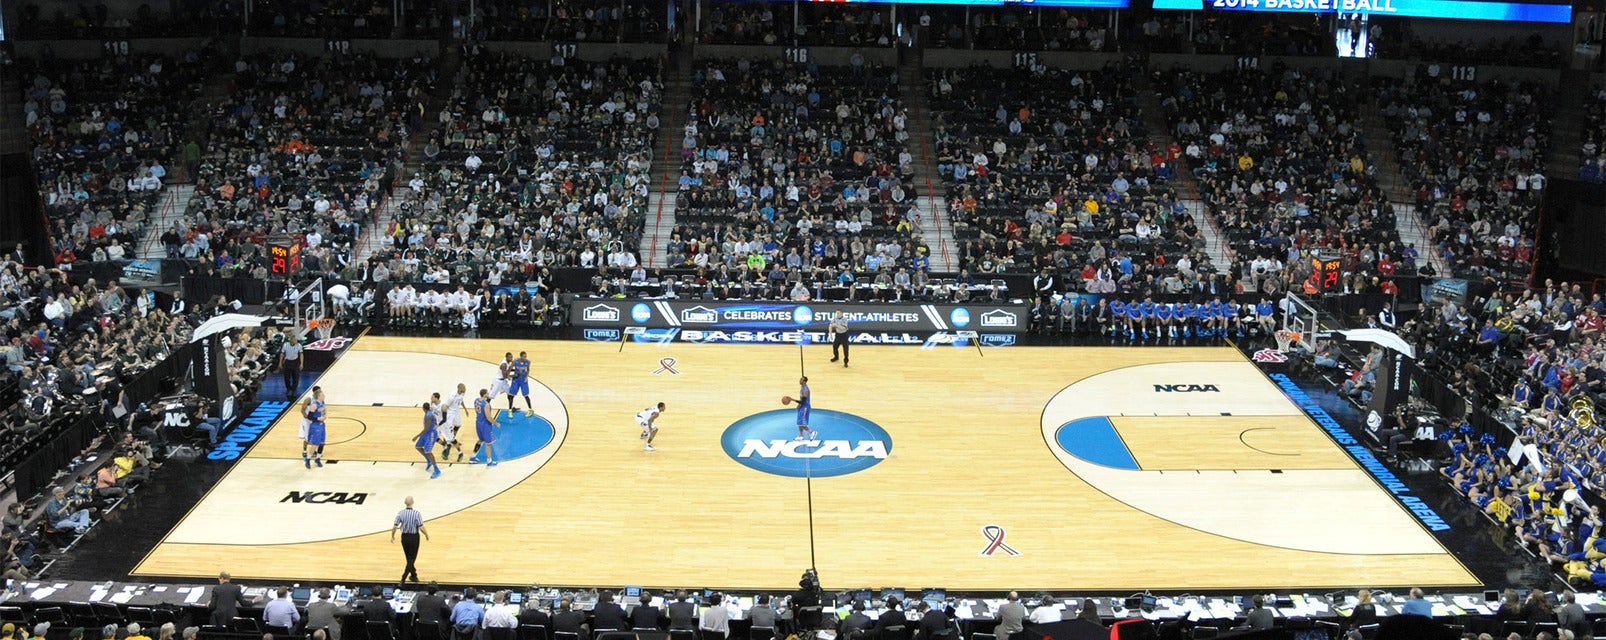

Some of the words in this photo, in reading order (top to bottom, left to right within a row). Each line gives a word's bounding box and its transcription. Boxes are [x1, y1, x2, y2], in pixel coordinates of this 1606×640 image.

[1213, 0, 1258, 8] 2014
[1265, 0, 1398, 13] BASKETBALL
[104, 41, 129, 56] 119
[555, 43, 576, 58] 117
[785, 48, 807, 63] 116
[1015, 52, 1037, 67] 115
[1237, 57, 1258, 71] 114
[1452, 66, 1475, 81] 113
[272, 256, 286, 273] 29
[1324, 271, 1339, 289] 29
[723, 311, 792, 321] CELEBRATES
[814, 311, 920, 323] STUENT-ATHLETES
[1152, 383, 1220, 393] NCAA
[206, 400, 291, 461] SPOKANE
[737, 438, 889, 459] NCAA
[1304, 404, 1358, 445] VETERANS
[1345, 445, 1410, 495] MEMORIAL
[1397, 495, 1451, 532] ARENA
[280, 491, 369, 505] NCAA
